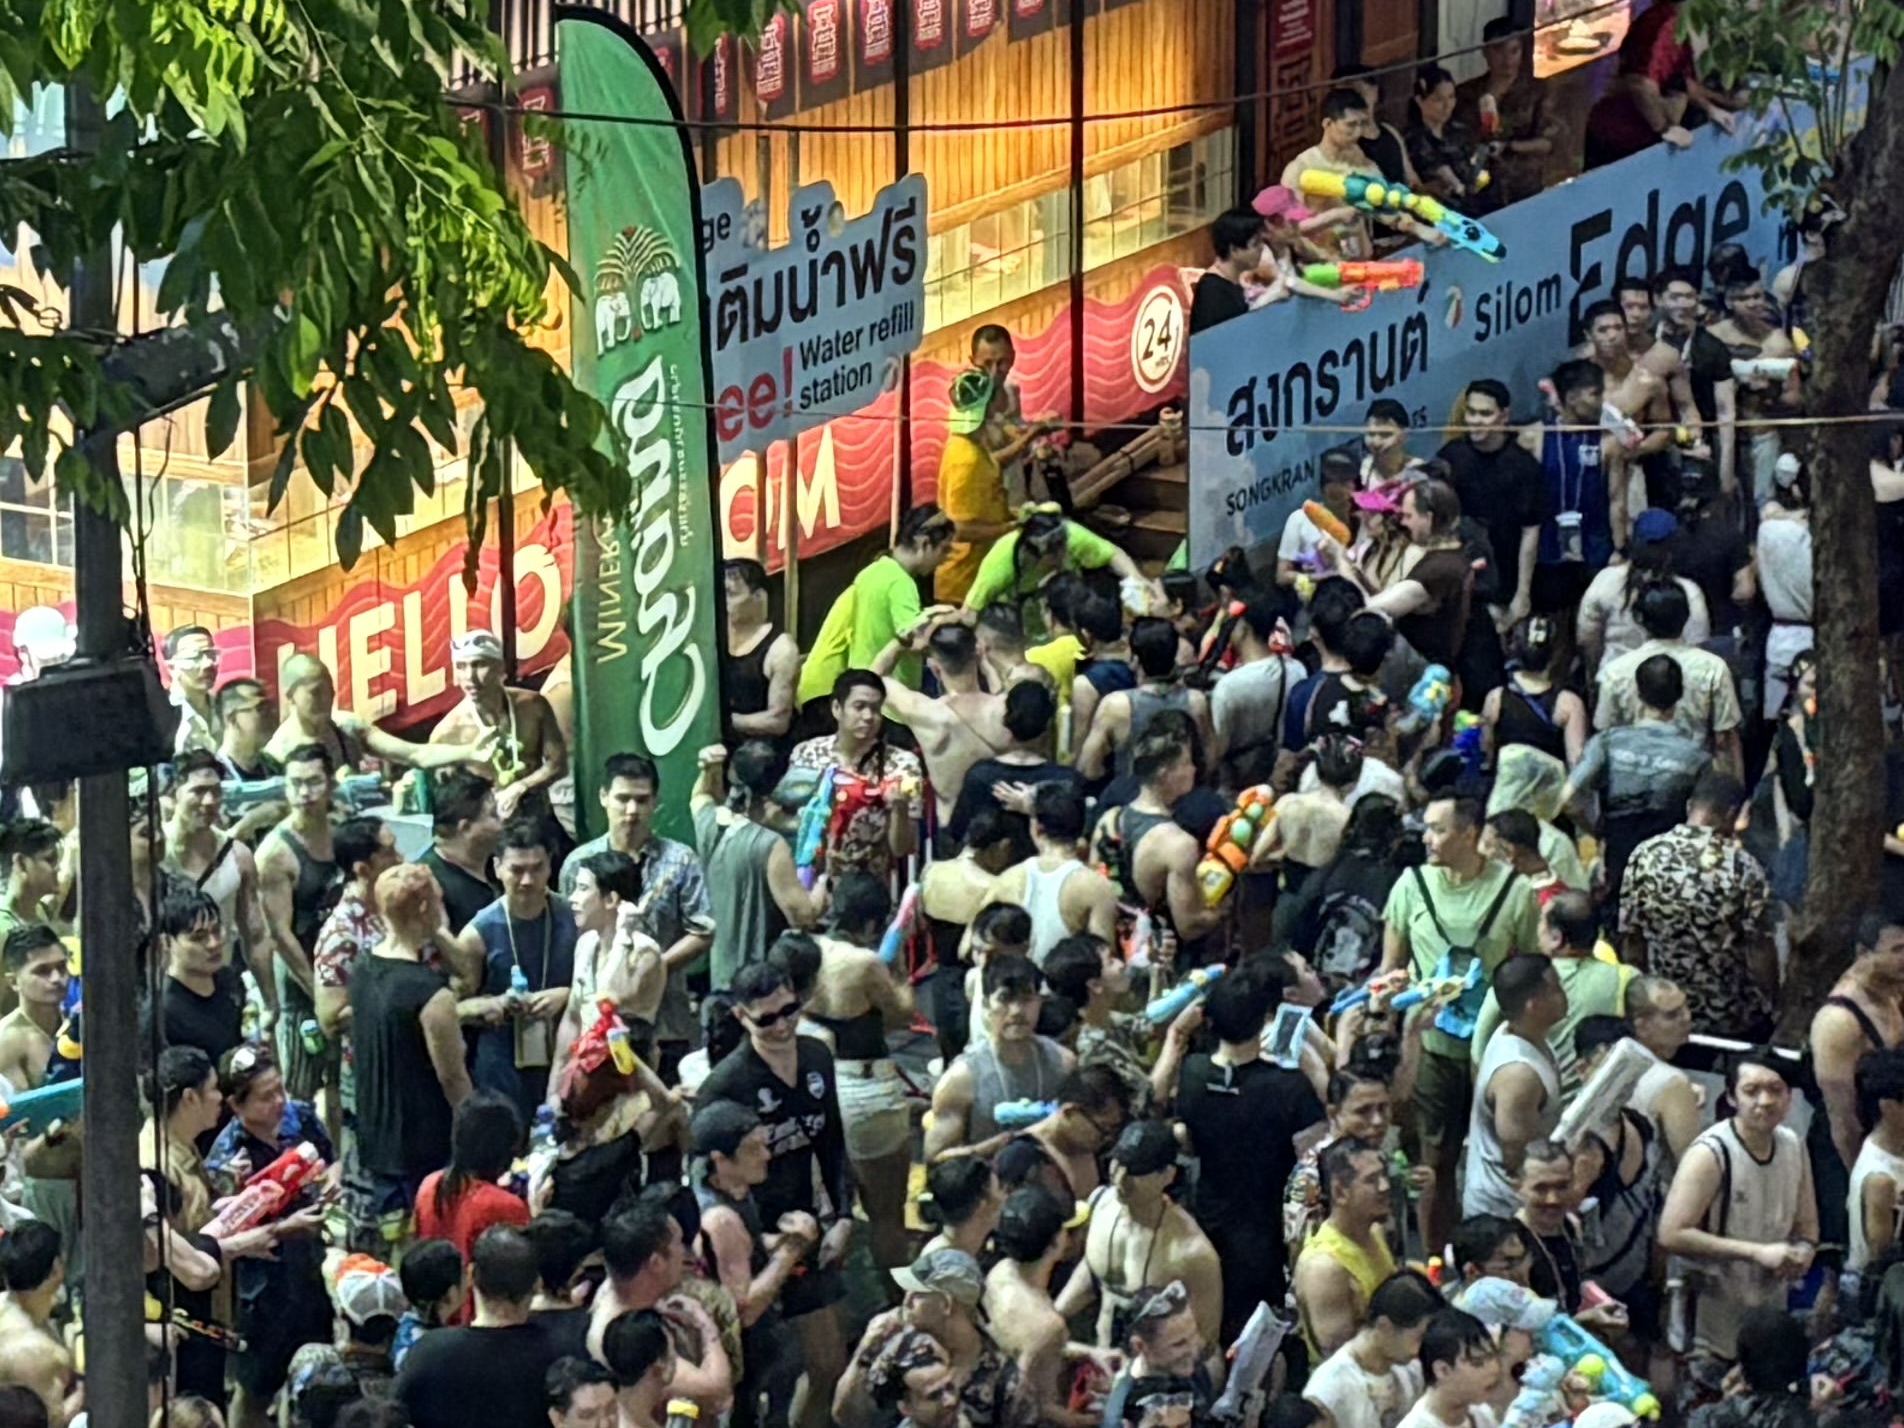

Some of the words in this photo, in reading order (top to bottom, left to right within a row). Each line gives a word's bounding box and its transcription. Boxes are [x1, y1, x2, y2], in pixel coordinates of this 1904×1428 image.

[1474, 273, 1562, 343] Silom
[1568, 179, 1750, 349] Edge
[799, 328, 865, 372] Water
[869, 300, 915, 347] refill
[1141, 309, 1173, 362] 24
[1225, 277, 1431, 457] สงกรานต์
[799, 361, 873, 410] station
[1225, 458, 1317, 516] SONGKRAN
